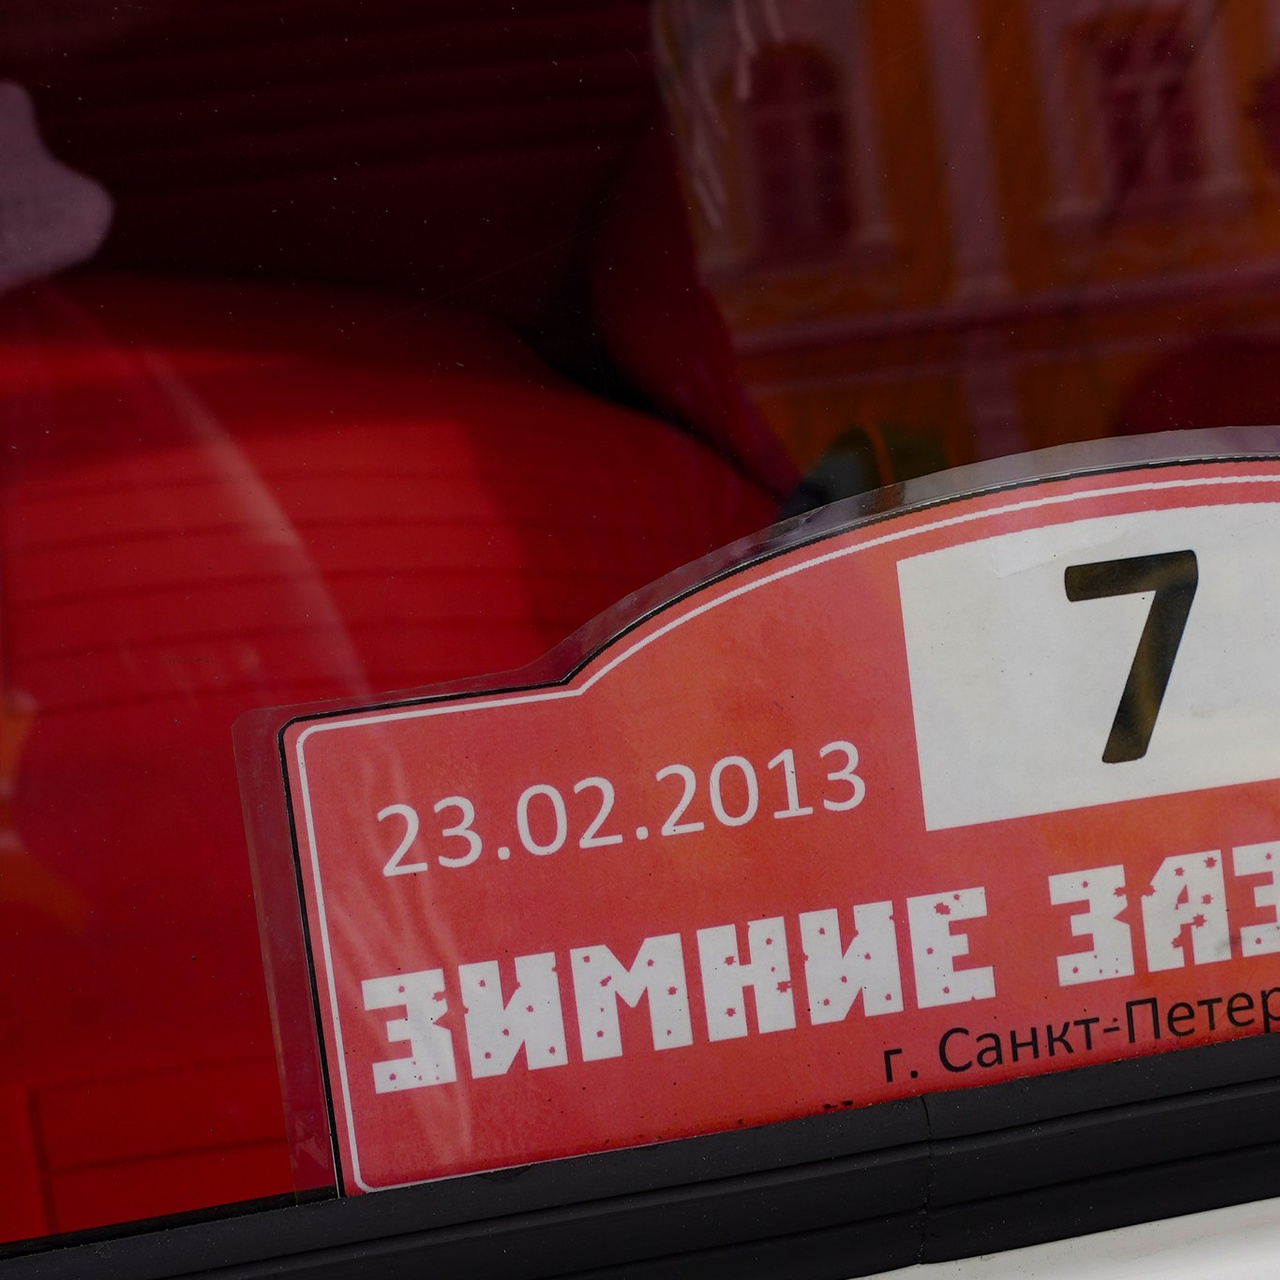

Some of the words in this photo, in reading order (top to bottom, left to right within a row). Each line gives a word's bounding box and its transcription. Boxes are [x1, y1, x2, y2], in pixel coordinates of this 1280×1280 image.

[1063, 549, 1199, 765] 7
[375, 739, 868, 878] 23.02.2013
[360, 886, 995, 1095] ЗИМНИЕ
[884, 1042, 920, 1083] г.
